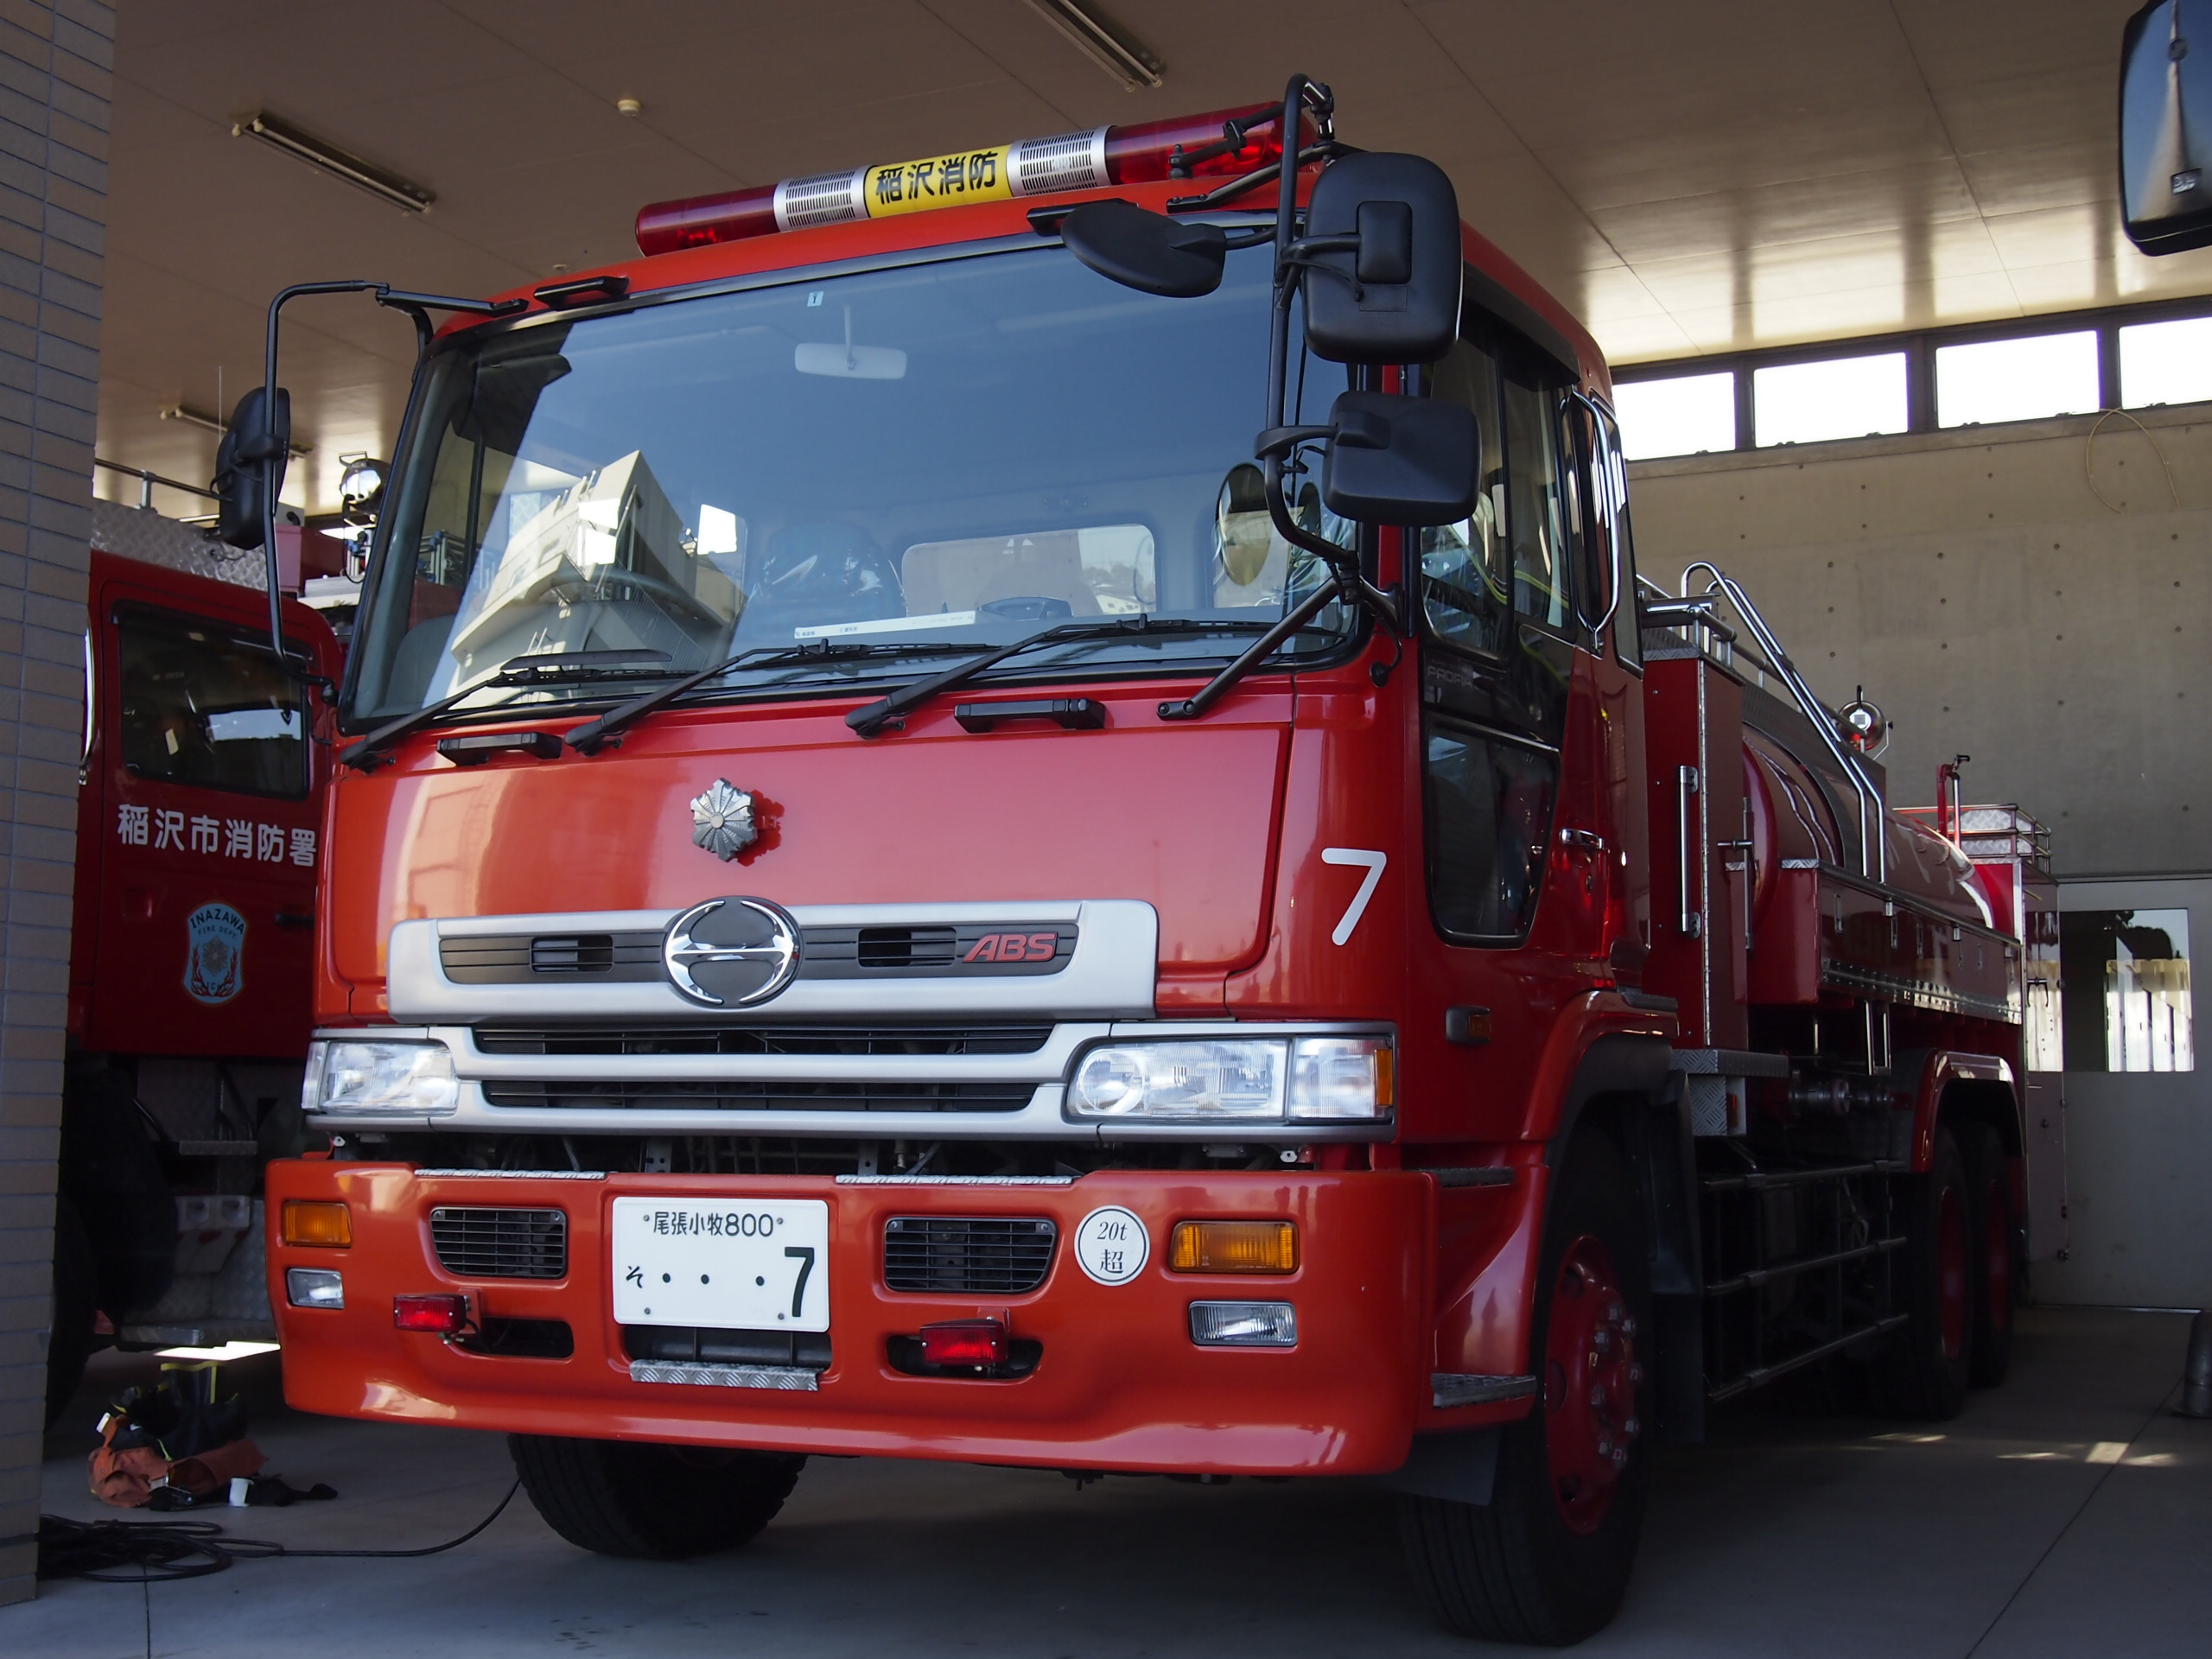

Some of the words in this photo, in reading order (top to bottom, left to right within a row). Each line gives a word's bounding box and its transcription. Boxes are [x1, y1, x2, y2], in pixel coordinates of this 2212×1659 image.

[875, 151, 998, 205] 稲沢消防
[118, 804, 316, 867] 稲沢市消防署
[1321, 848, 1387, 946] 7
[190, 908, 245, 934] INAZAWA
[198, 925, 216, 936] FIRE
[219, 925, 237, 938] DEPT
[963, 932, 1057, 963] ABS
[1096, 1221, 1128, 1241] 20t
[1099, 1249, 1123, 1274] 超
[626, 1265, 644, 1288] そ
